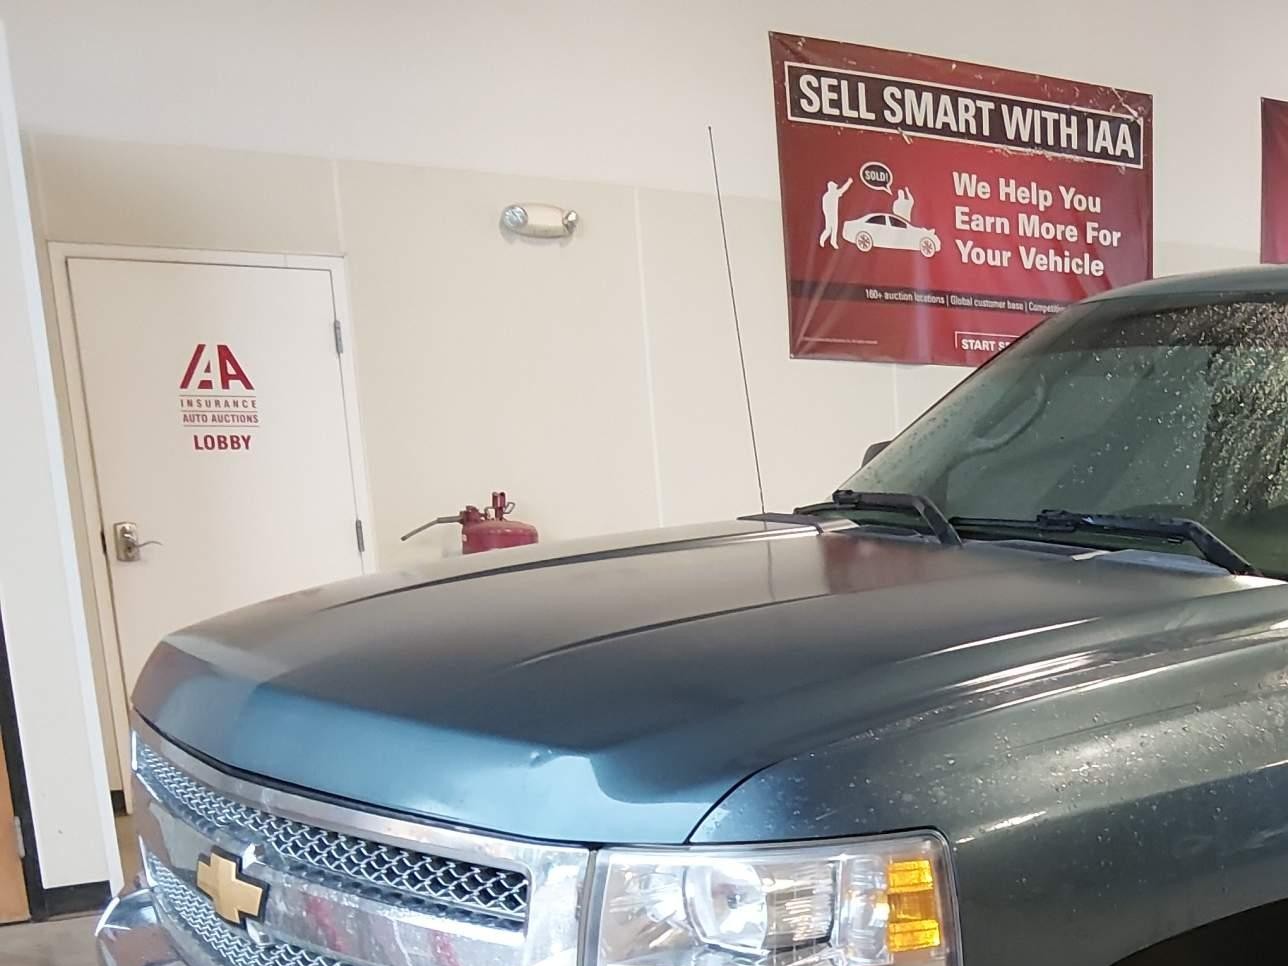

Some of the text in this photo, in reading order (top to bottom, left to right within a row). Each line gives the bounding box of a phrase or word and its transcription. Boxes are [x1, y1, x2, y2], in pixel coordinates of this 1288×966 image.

[799, 74, 1136, 158] SELL SMART WITH IAA
[864, 170, 889, 182] SOLD!
[952, 171, 1102, 213] We Help You
[955, 206, 1122, 248] Earn More For
[955, 240, 1105, 277] Your Vehicle
[884, 291, 913, 301] auction
[914, 292, 945, 305] locations
[950, 295, 973, 307] Global
[974, 298, 1006, 309] customer
[1007, 300, 1024, 311] base
[961, 338, 995, 351] START
[180, 399, 257, 409] INSURANCE
[183, 413, 259, 424] AUTO AUCTIONS
[193, 434, 252, 451] LOBBY
